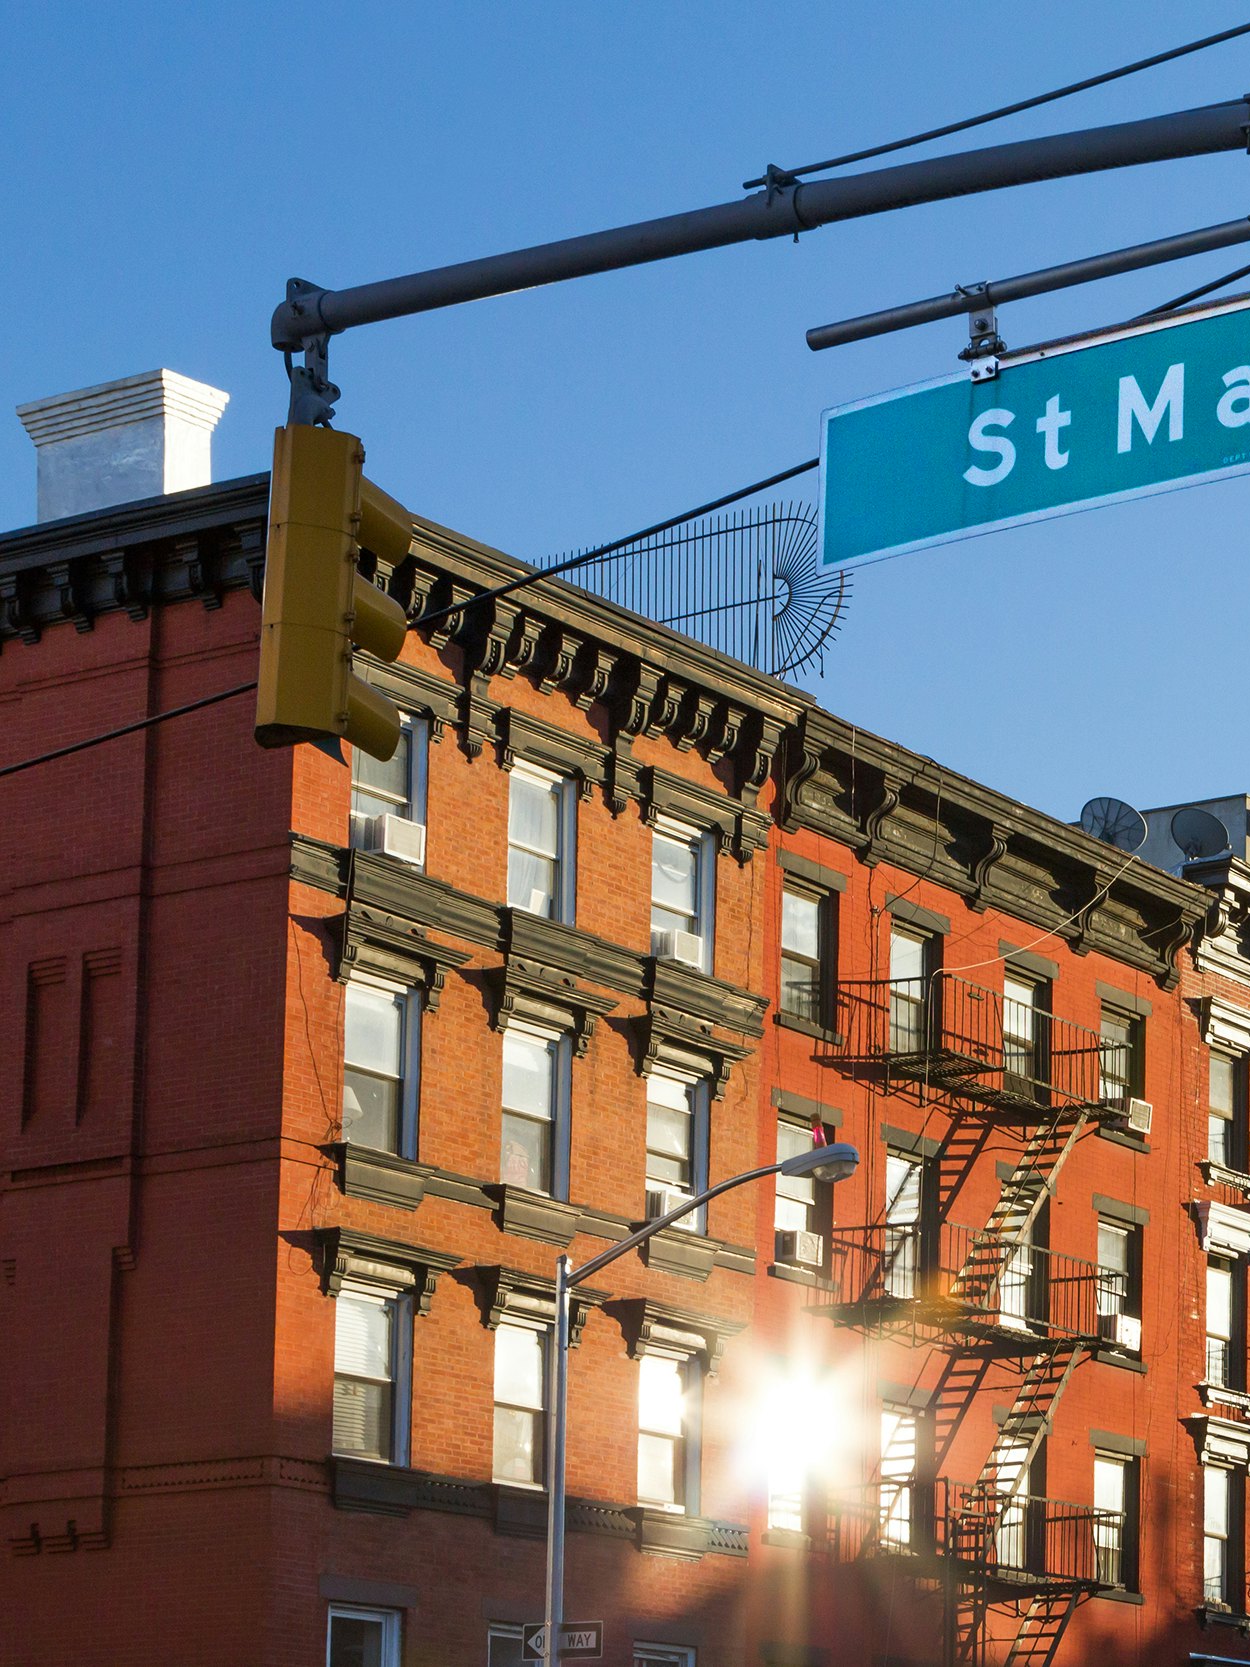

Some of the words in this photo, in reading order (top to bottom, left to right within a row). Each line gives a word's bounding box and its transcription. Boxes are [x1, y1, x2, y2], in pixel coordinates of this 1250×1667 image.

[963, 394, 1071, 487] St
[1222, 452, 1246, 464] DEPT
[567, 1633, 592, 1648] WAY
